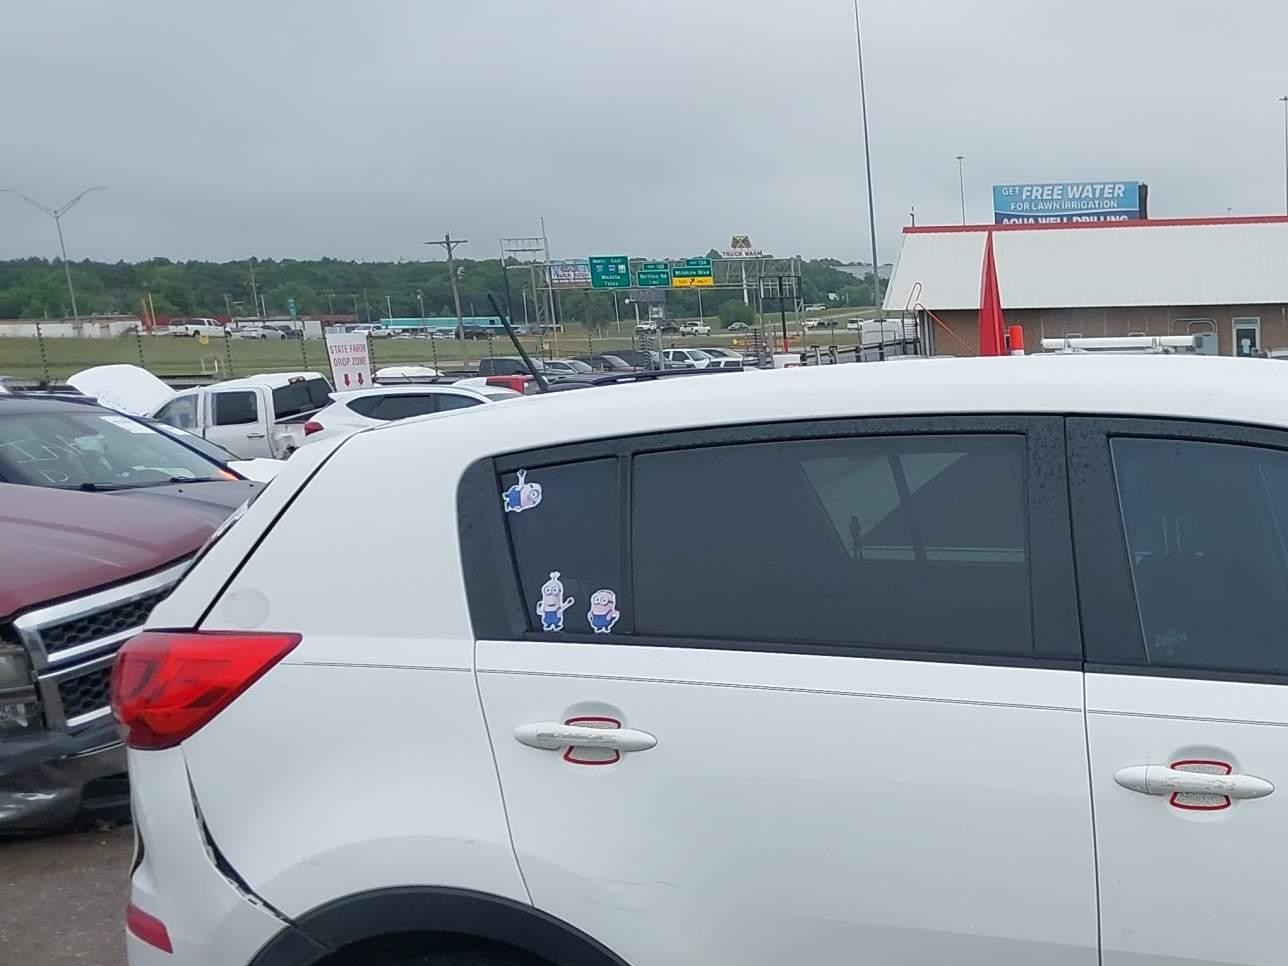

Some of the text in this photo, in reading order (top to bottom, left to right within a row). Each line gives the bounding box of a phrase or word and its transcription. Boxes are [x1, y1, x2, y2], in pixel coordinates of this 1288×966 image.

[1002, 183, 1126, 200] GET FREE WATER
[1010, 199, 1118, 211] FOR LAWN IRRIGATION
[329, 343, 366, 354] STATE FARM
[334, 356, 367, 368] DROP ZONE
